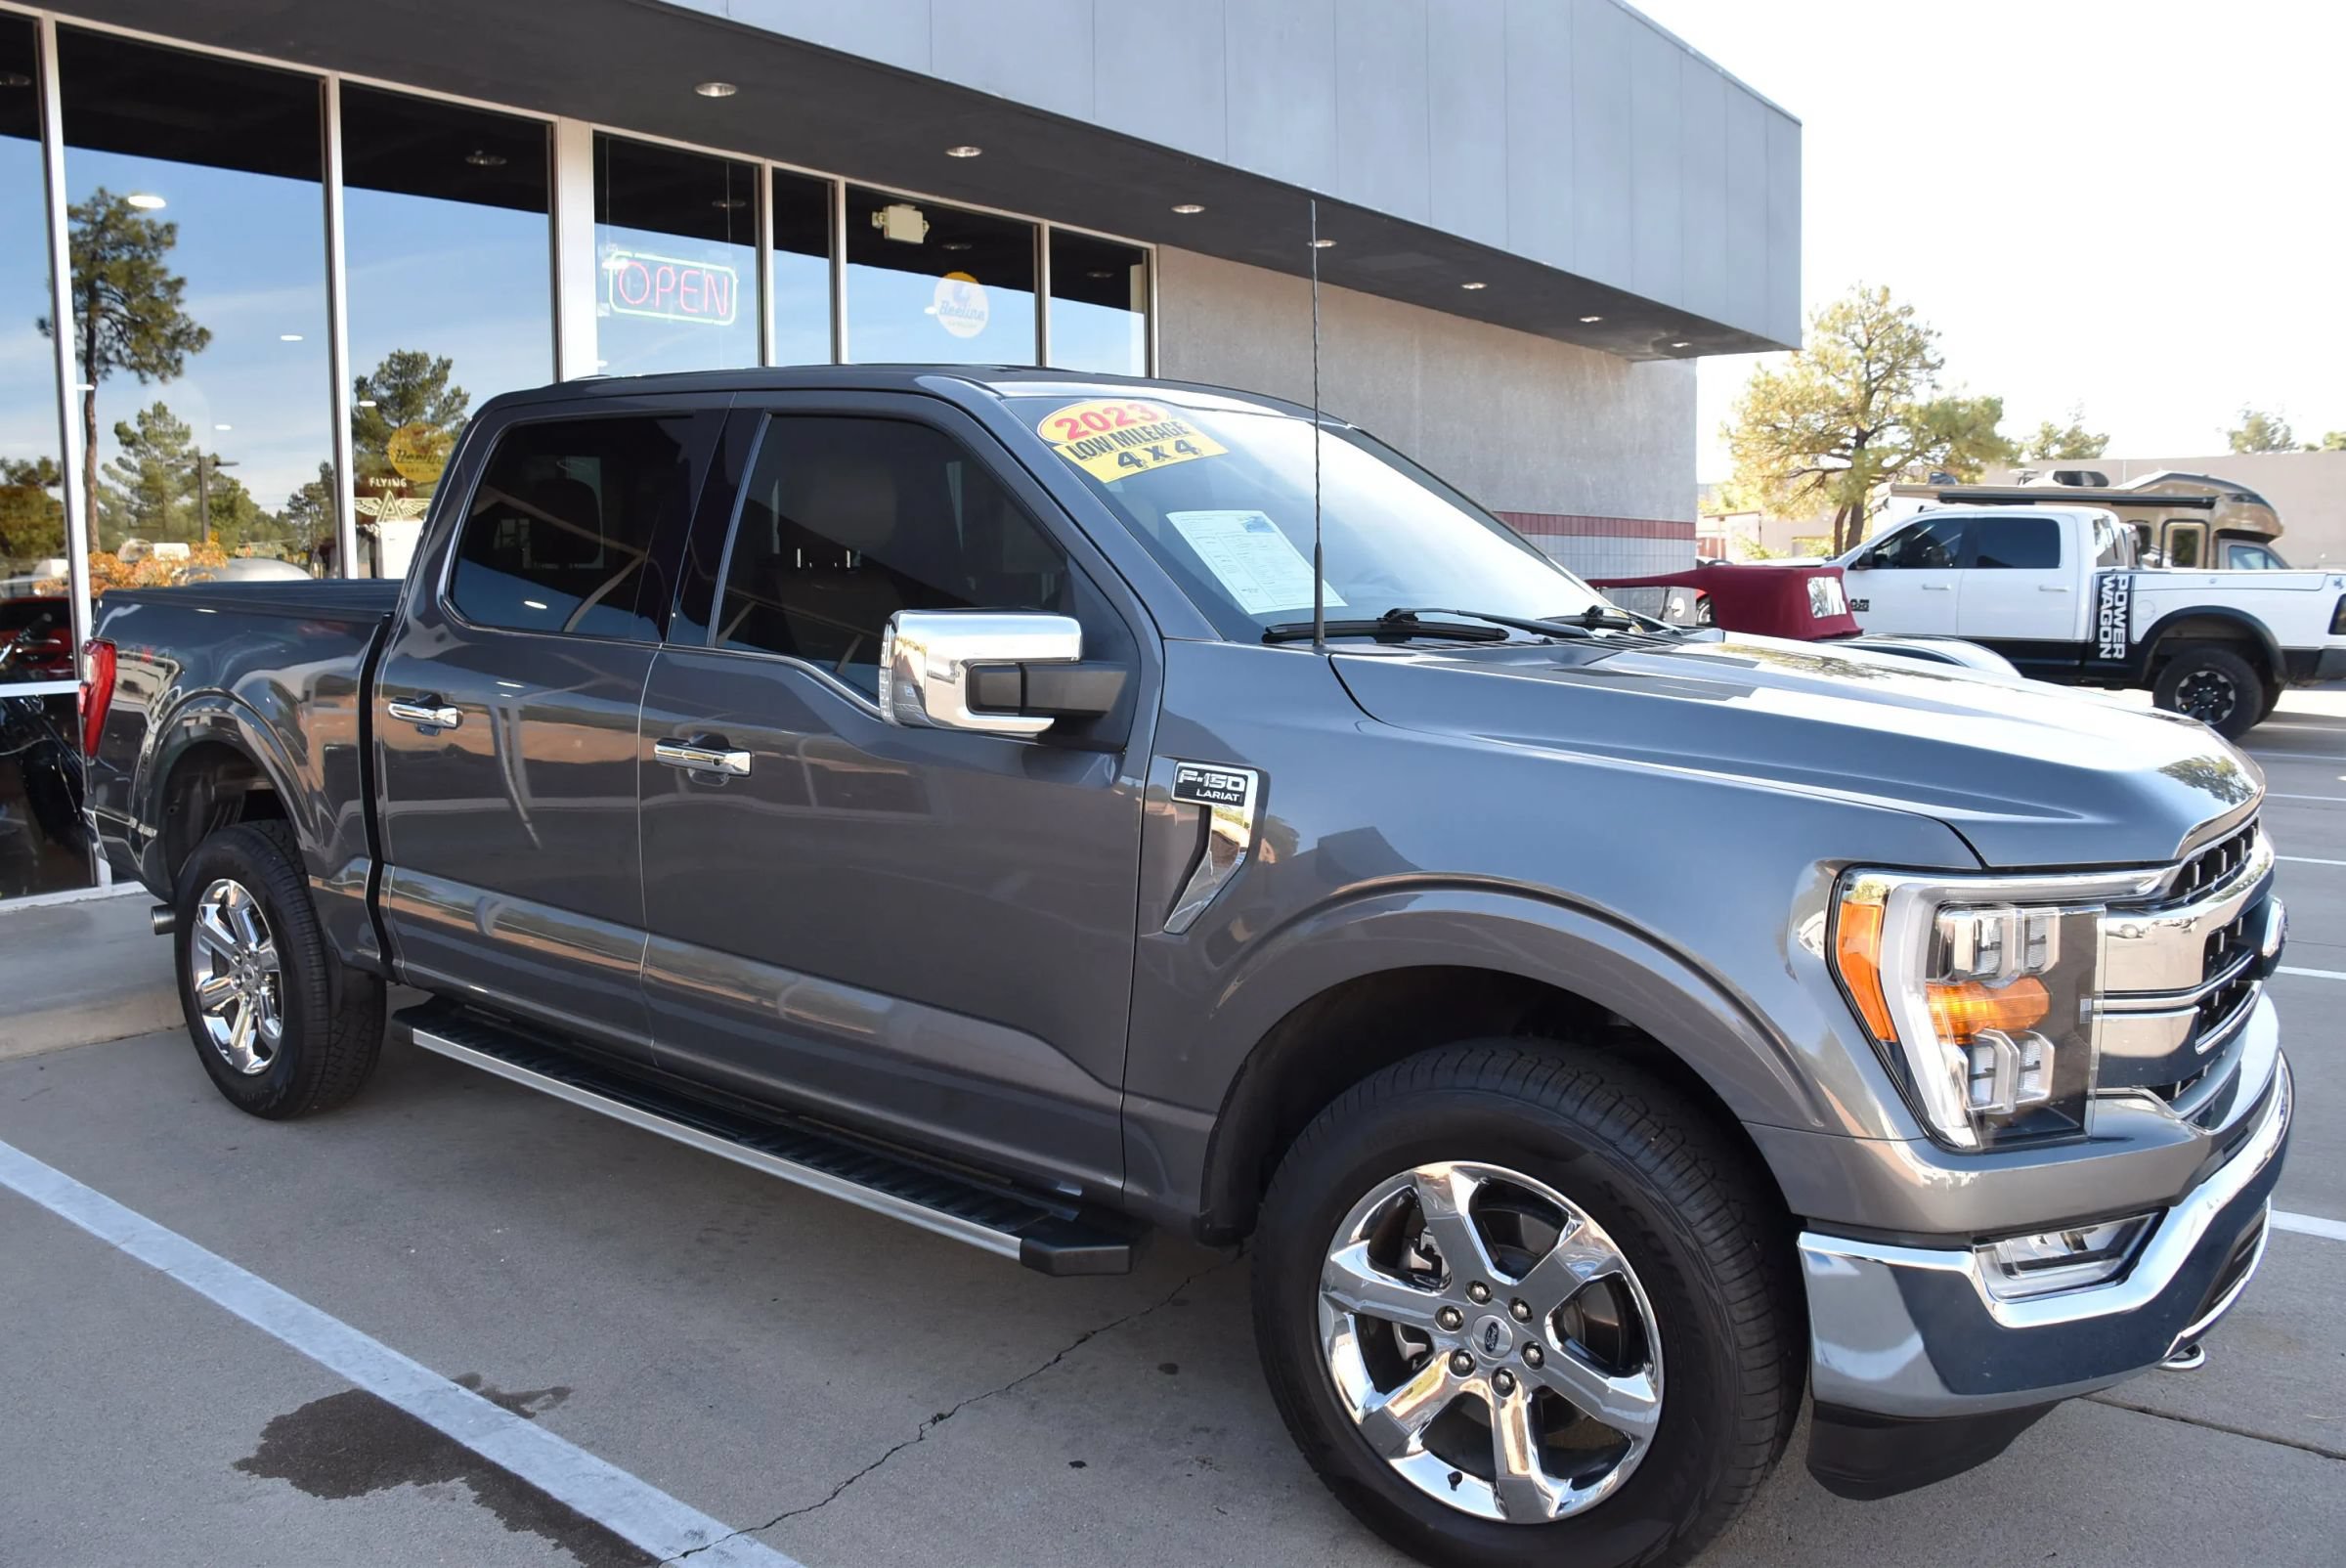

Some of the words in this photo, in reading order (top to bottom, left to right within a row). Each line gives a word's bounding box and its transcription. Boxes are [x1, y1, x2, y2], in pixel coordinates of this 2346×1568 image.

[618, 261, 728, 316] OPEN
[1055, 403, 1159, 440] 2023
[1065, 434, 1115, 461] LOW
[1108, 420, 1192, 449] MILEAGE
[369, 478, 408, 488] FLYING
[2099, 575, 2116, 659] WAGON
[2112, 575, 2129, 659] POWER
[1178, 769, 1246, 792] F-150
[1195, 789, 1240, 802] LARIAT
[1485, 1324, 1499, 1350] Ford
